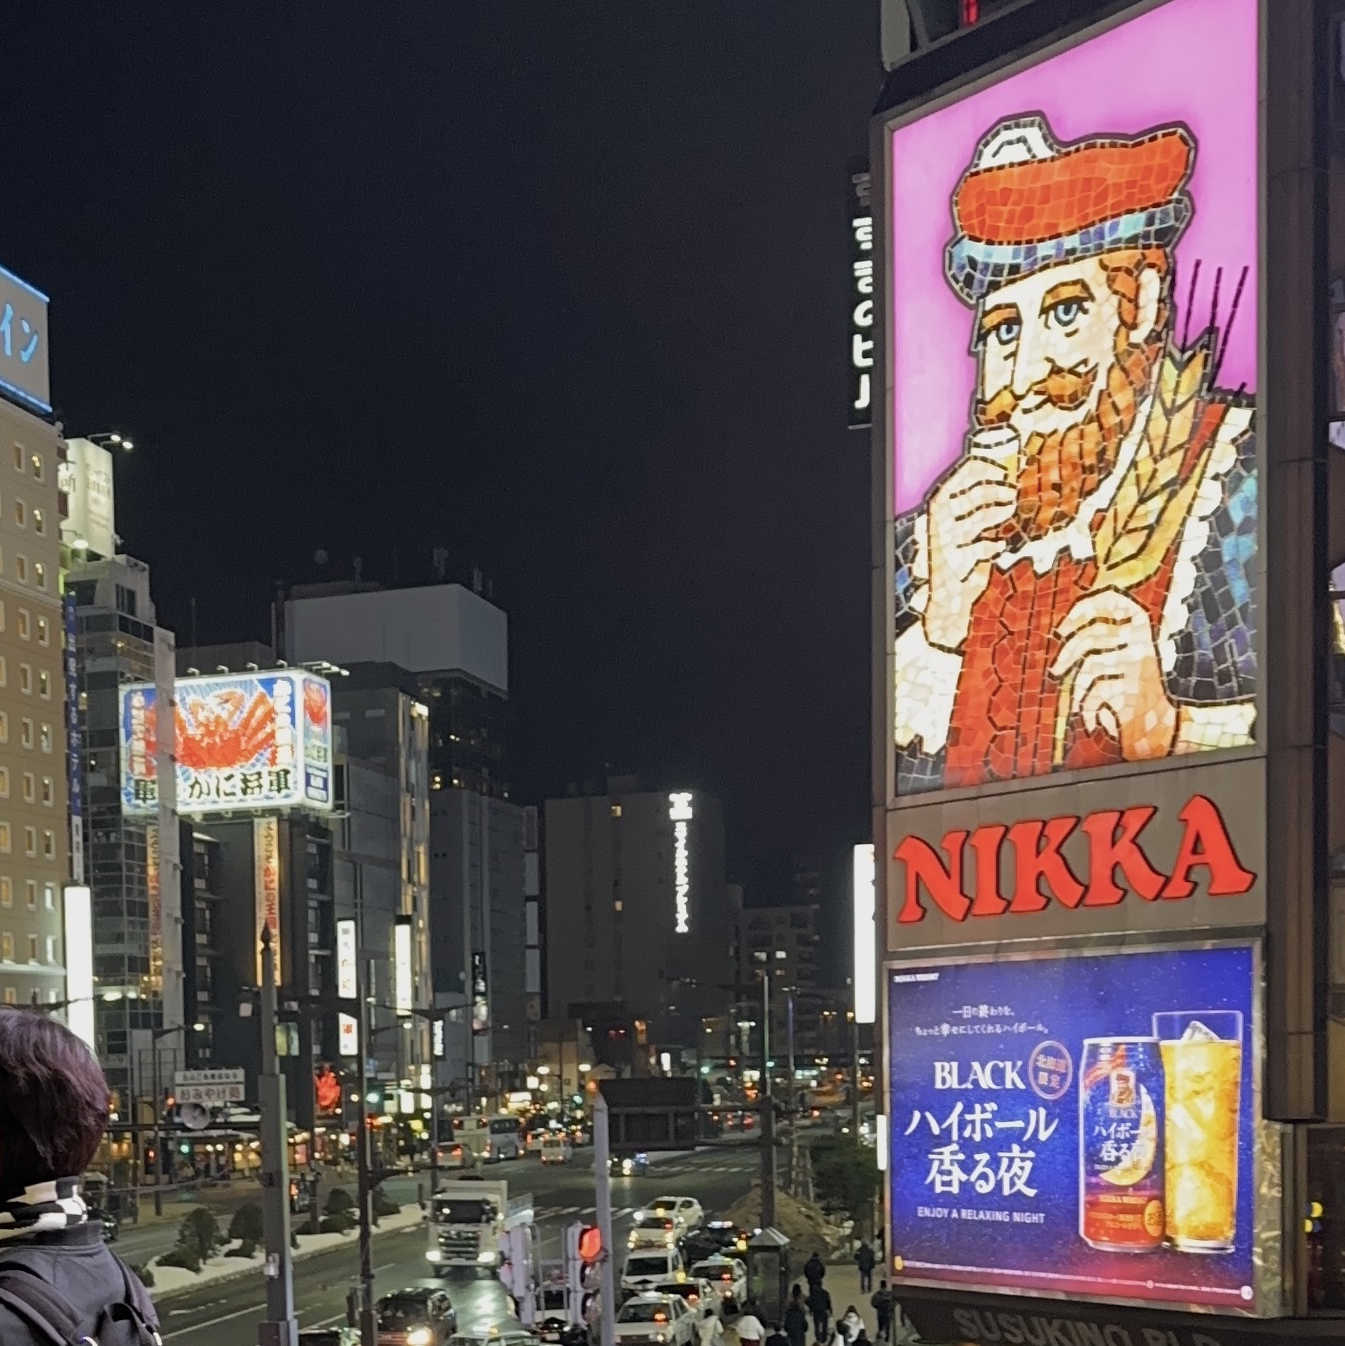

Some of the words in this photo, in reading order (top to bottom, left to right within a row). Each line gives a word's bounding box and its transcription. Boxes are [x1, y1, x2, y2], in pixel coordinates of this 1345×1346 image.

[187, 767, 291, 800] かに将軍
[893, 793, 1257, 923] NIKKA
[934, 1058, 1026, 1091] BLACK
[904, 1102, 1058, 1143] ハイボール
[925, 1144, 1038, 1197] 香る夜
[917, 1207, 949, 1220] ENJOY
[951, 1208, 959, 1220] A
[960, 1208, 1010, 1222] RELAXING
[1012, 1211, 1046, 1224] NIGHT
